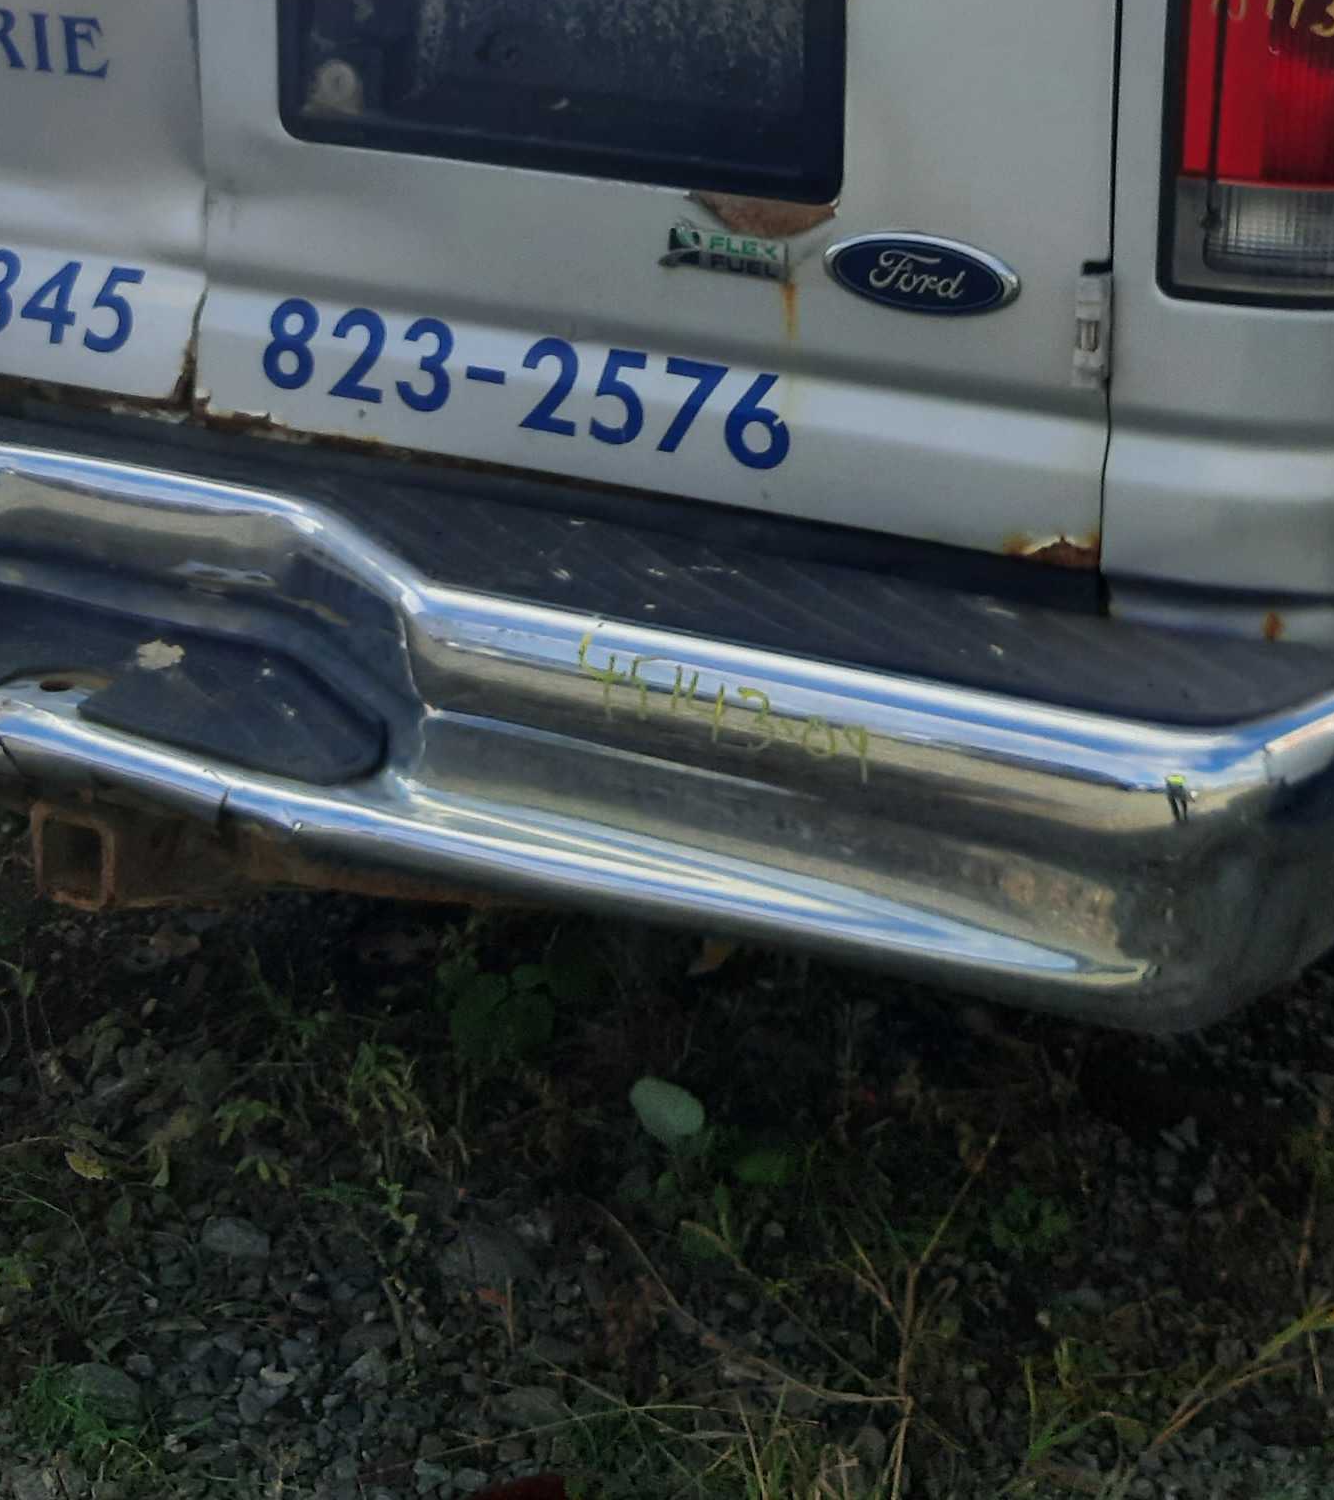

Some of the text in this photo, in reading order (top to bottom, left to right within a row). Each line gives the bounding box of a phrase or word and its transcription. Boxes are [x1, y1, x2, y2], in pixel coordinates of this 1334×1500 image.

[709, 235, 778, 261] FLEX
[709, 253, 780, 279] FUEL
[868, 249, 966, 300] Ford
[263, 297, 791, 471] 823-2576
